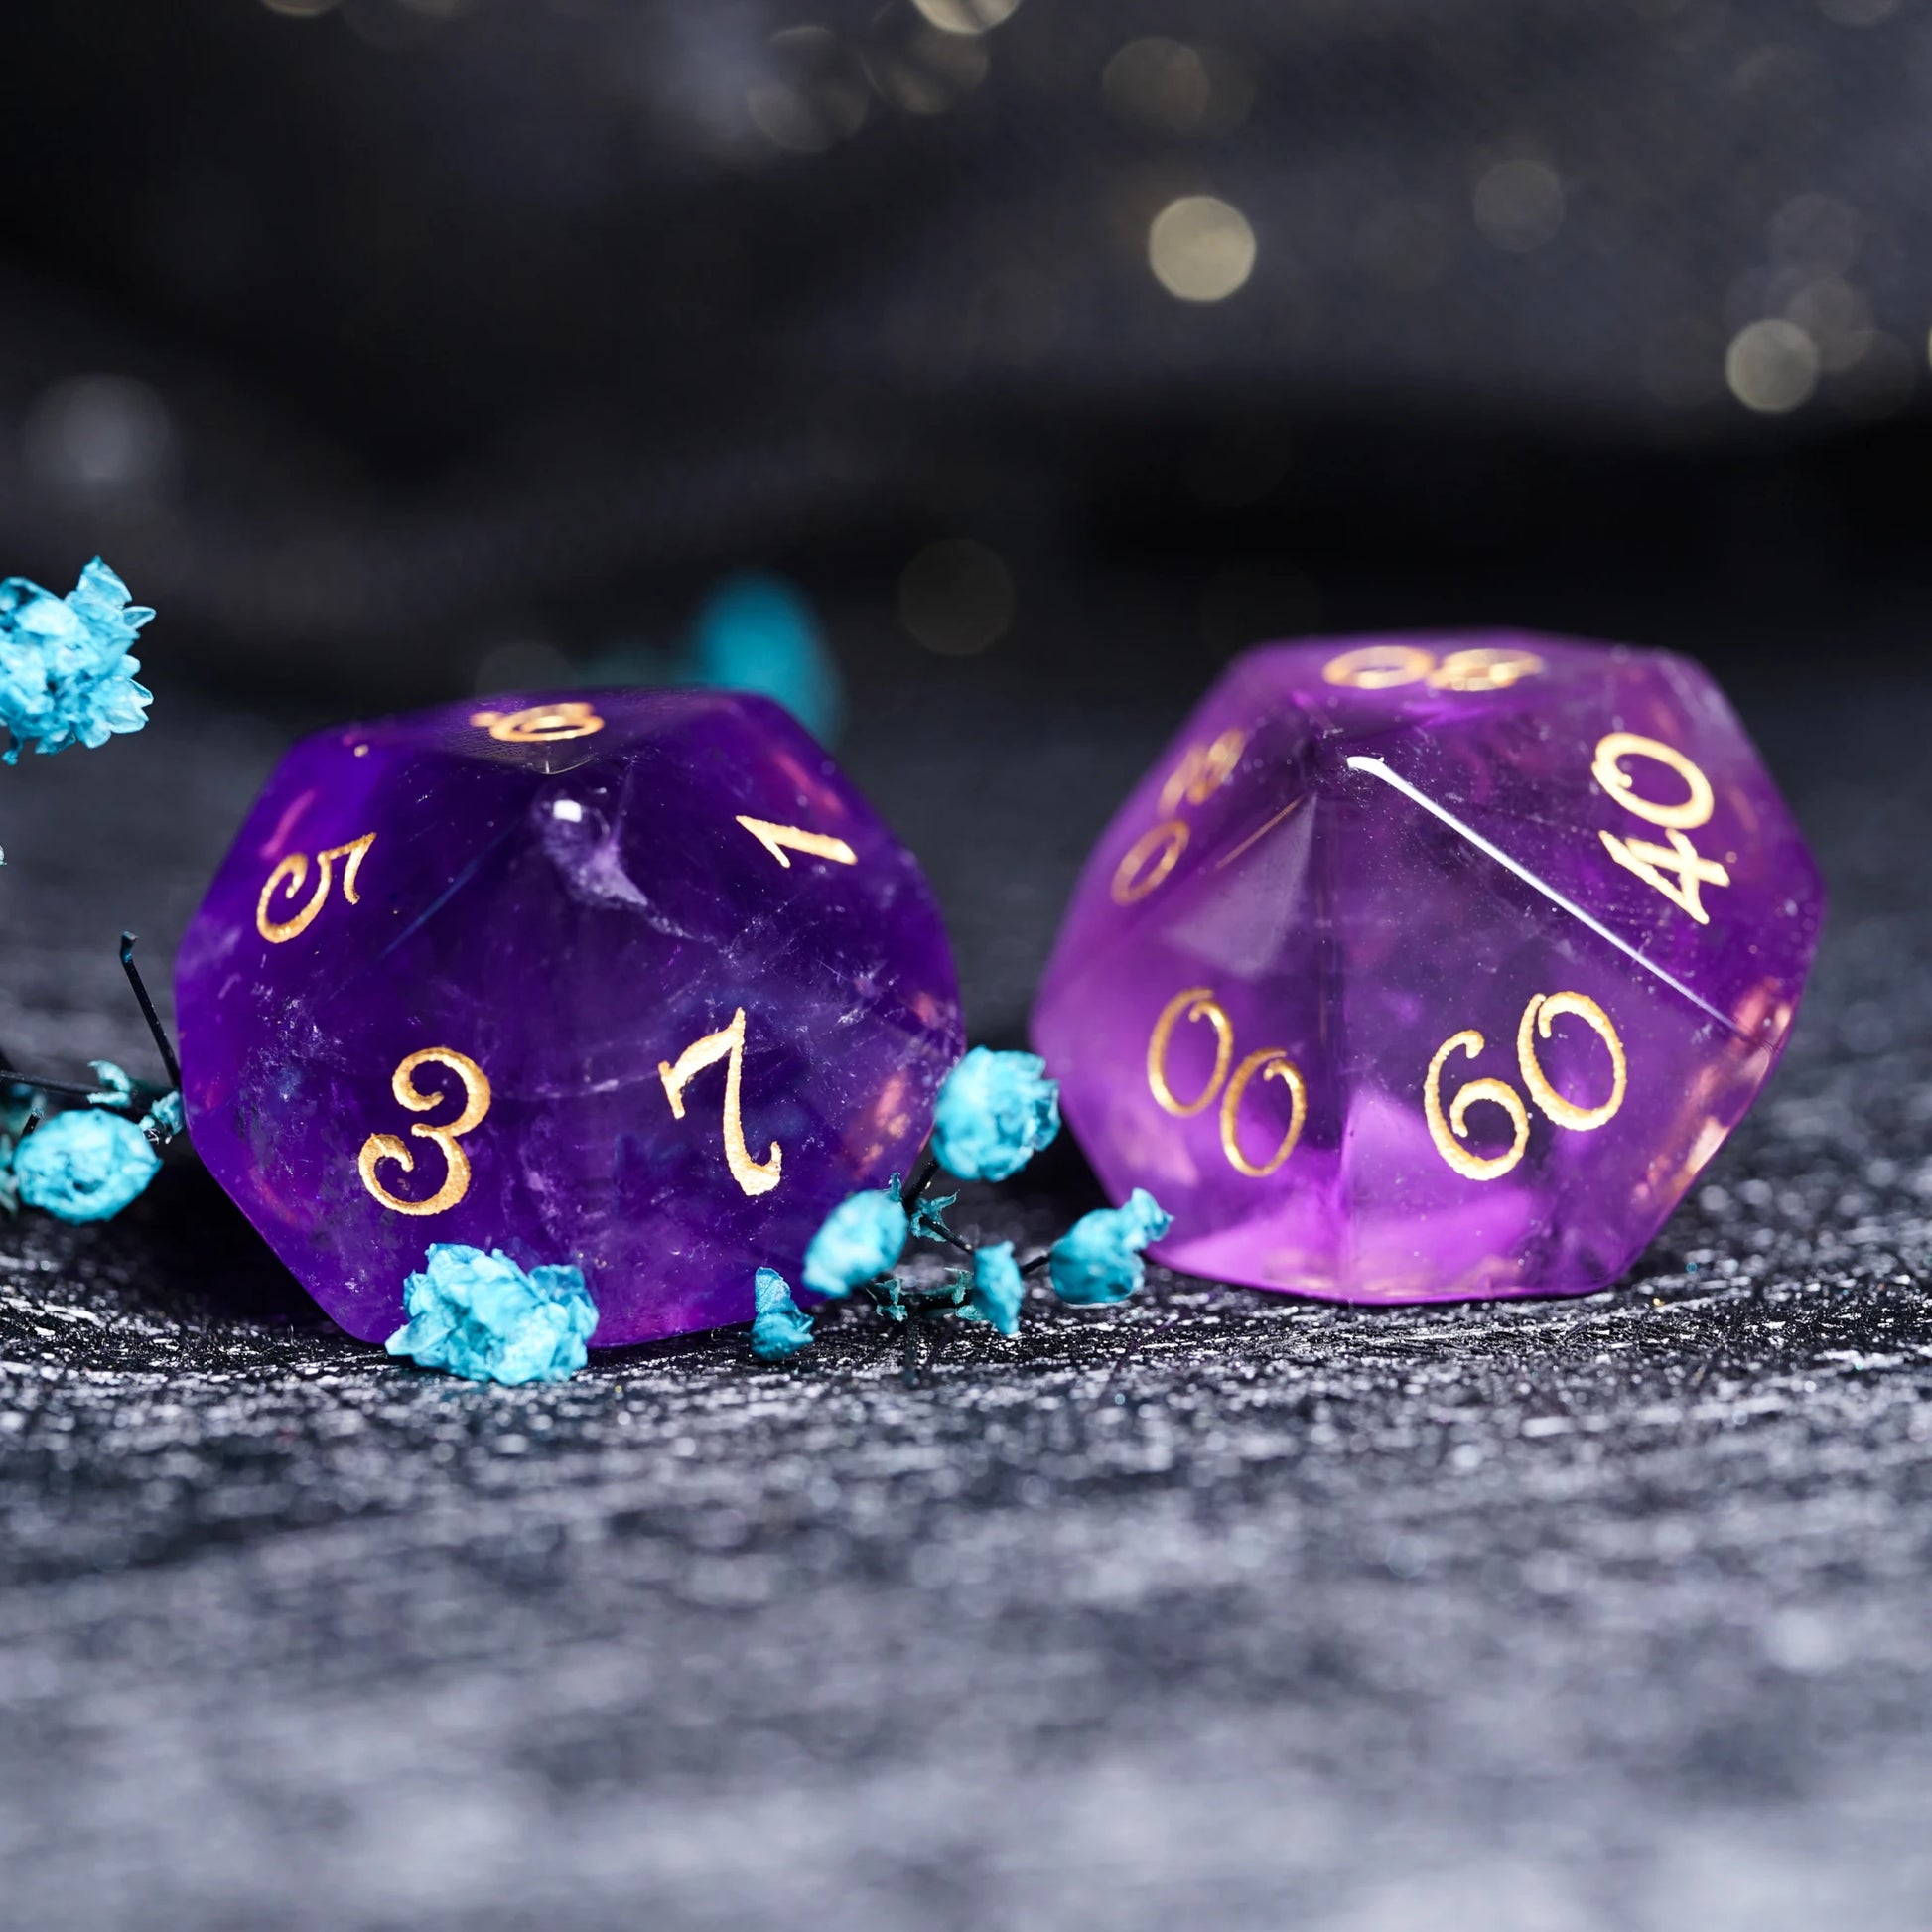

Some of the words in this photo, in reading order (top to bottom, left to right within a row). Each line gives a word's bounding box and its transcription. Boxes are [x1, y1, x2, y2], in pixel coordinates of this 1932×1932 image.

[256, 832, 375, 944] 5
[736, 815, 857, 868] 1
[1591, 732, 1729, 924] 40
[358, 1047, 491, 1216] 3
[658, 1007, 782, 1194] 7
[1147, 988, 1306, 1177] 00
[1424, 991, 1627, 1180] 60
